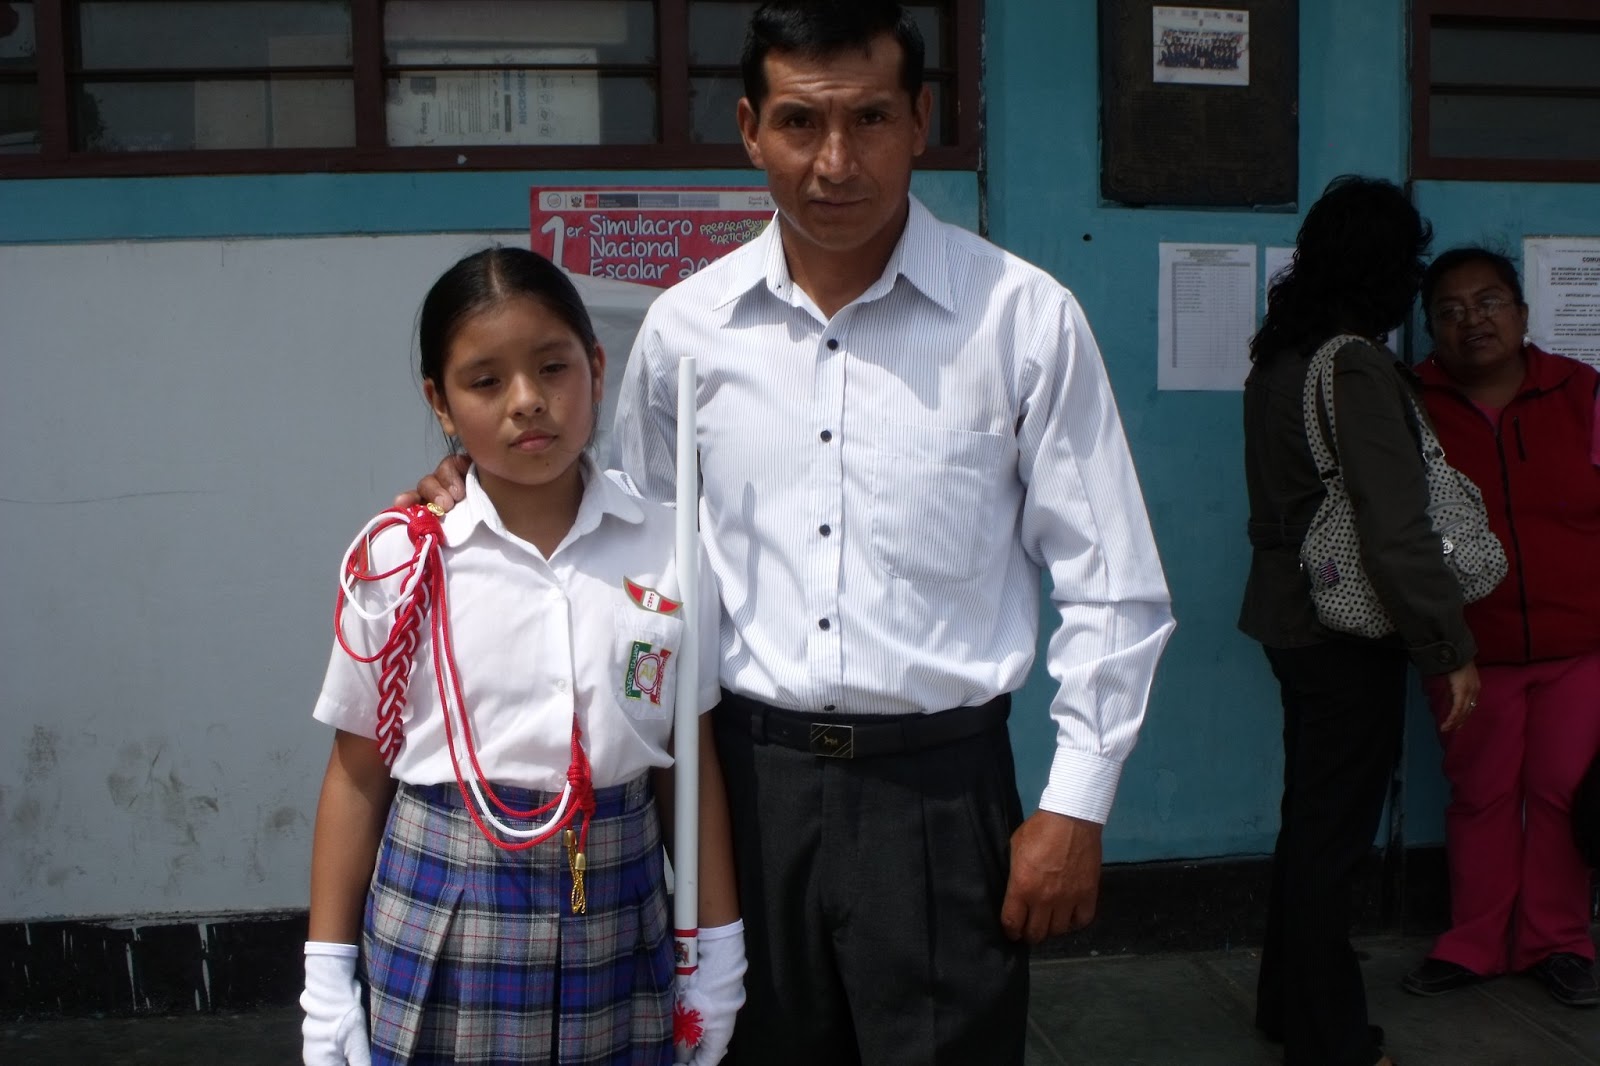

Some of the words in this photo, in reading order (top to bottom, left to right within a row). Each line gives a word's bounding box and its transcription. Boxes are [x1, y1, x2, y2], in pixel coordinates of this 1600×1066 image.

[589, 213, 693, 237] Simulacro
[589, 236, 679, 258] Nacional
[589, 257, 670, 279] Escolar
